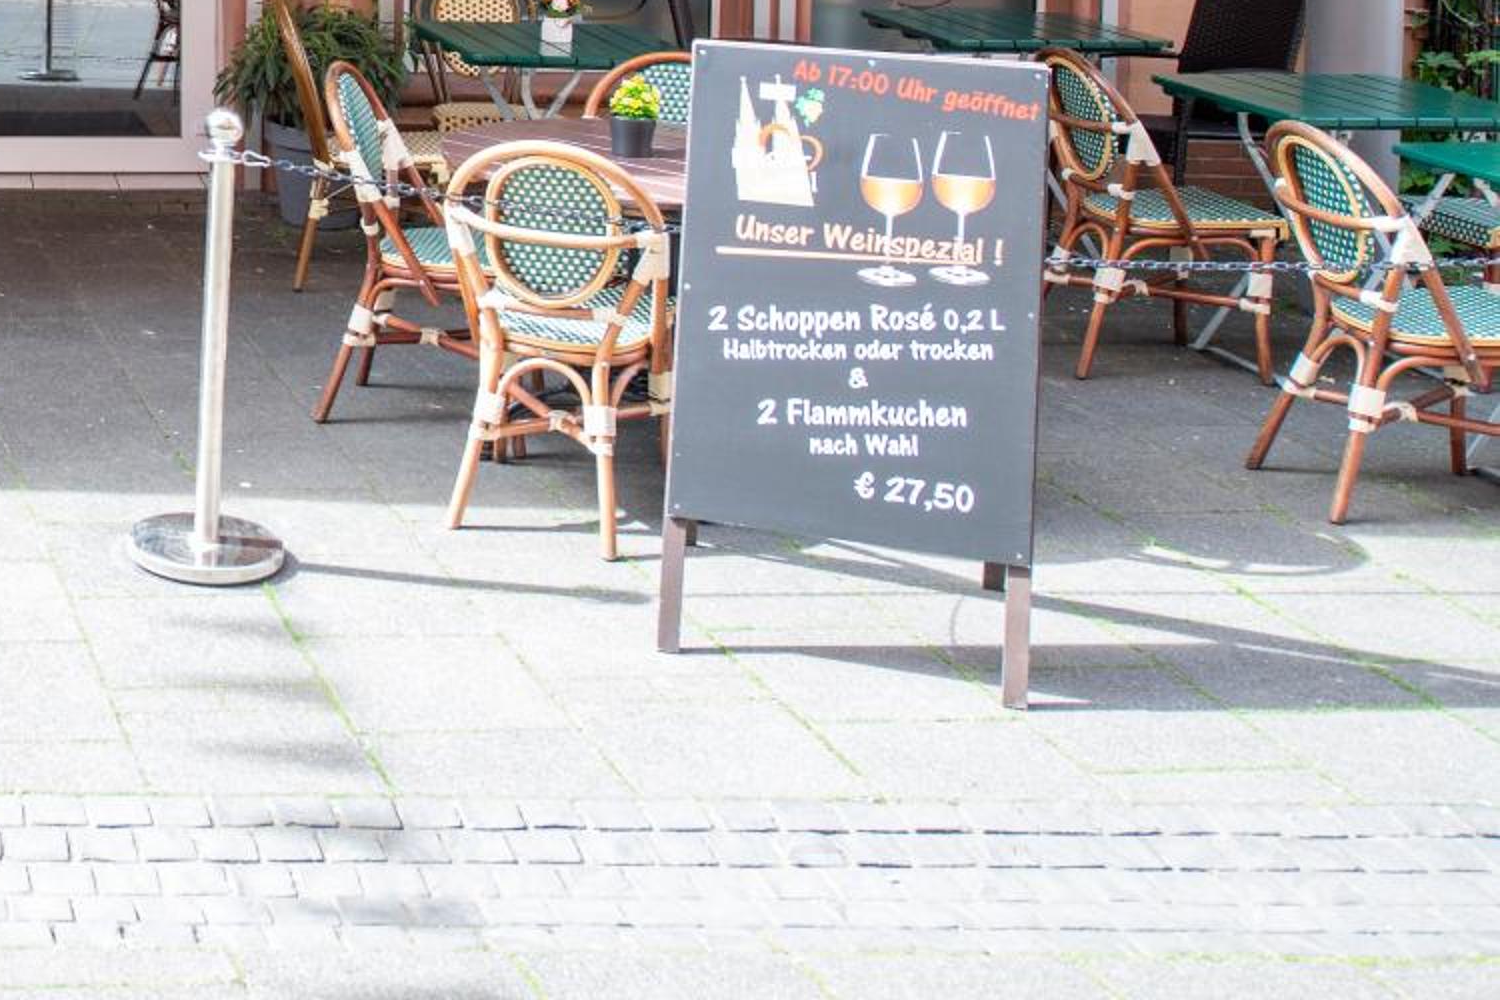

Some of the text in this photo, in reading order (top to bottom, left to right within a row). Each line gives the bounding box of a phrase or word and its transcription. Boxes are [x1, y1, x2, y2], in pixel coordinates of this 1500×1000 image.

[793, 59, 1042, 121] Ab 17:00 Uhr geöffnet
[735, 214, 1003, 266] Unser Weinspezial !
[707, 303, 1006, 338] 2 Schoppen Rosé 0,2 L
[723, 338, 994, 360] Halbtrocken oder trocken
[848, 367, 869, 389] &
[757, 398, 968, 428] 2 Flammkuchen
[809, 434, 919, 456] nach Wahl
[853, 471, 975, 513] € 27,50
